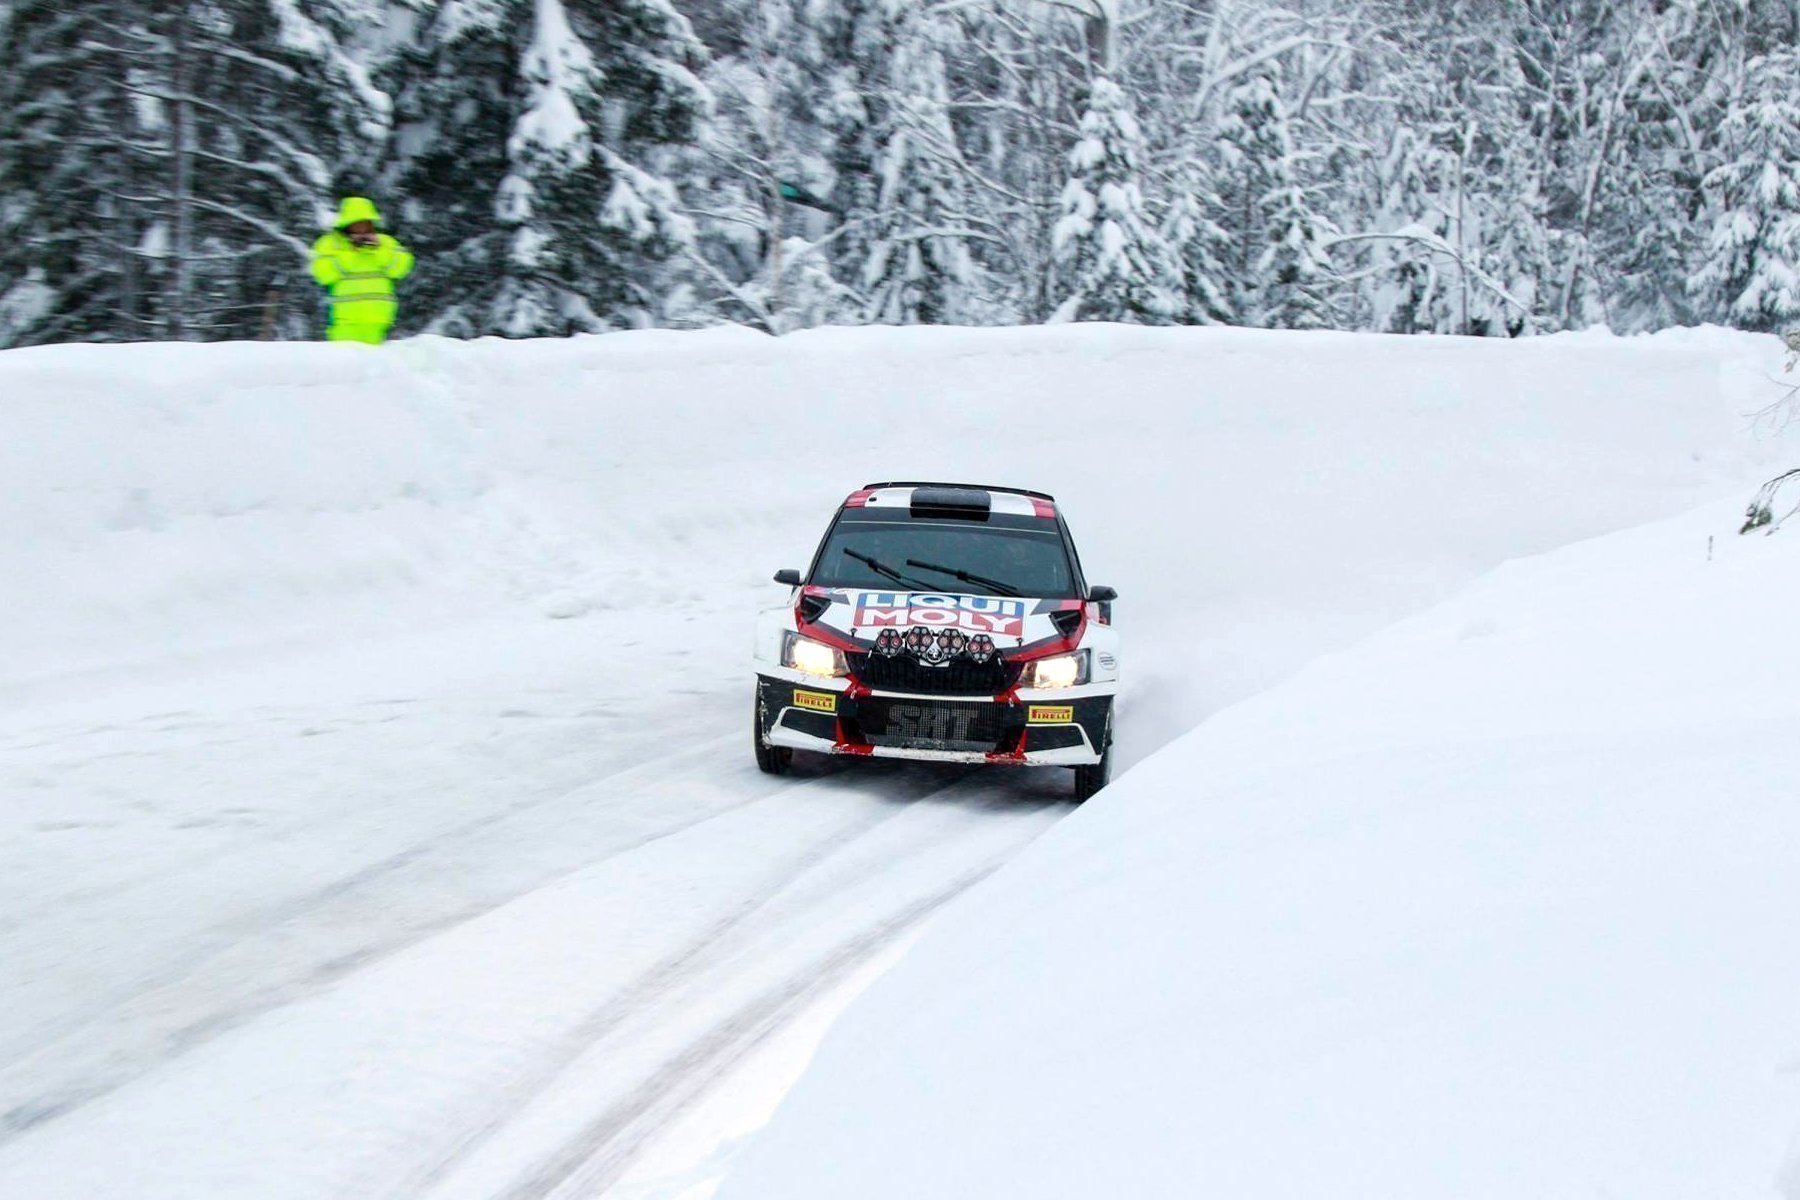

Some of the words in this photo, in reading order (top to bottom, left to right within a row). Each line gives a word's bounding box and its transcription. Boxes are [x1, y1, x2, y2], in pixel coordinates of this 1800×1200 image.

[866, 593, 1019, 615] LIQUI
[863, 609, 1020, 633] MOLY
[796, 692, 832, 708] PIRELLI
[1031, 708, 1071, 720] PIRELLI
